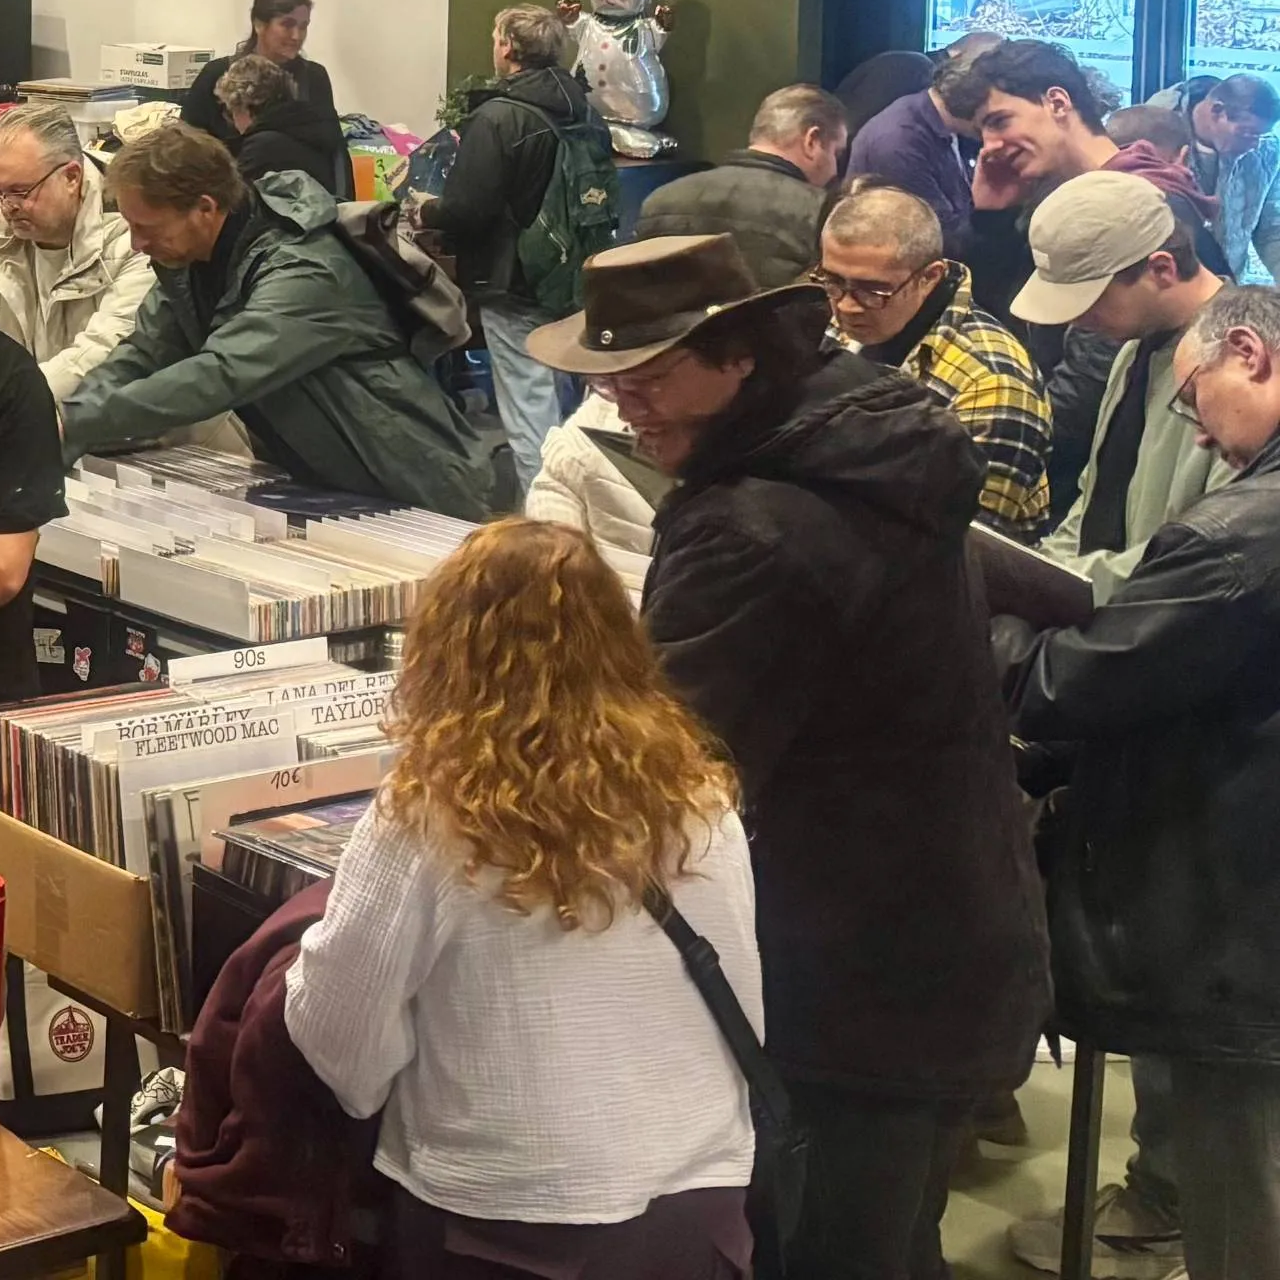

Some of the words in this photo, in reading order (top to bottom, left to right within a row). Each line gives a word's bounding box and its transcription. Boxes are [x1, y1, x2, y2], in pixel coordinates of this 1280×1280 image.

[233, 649, 266, 669] 90s
[311, 699, 386, 725] TAYLOR
[135, 727, 238, 757] FLEETWOOD
[241, 718, 280, 739] MAC
[270, 766, 301, 790] 10€
[53, 1032, 90, 1046] TRADER
